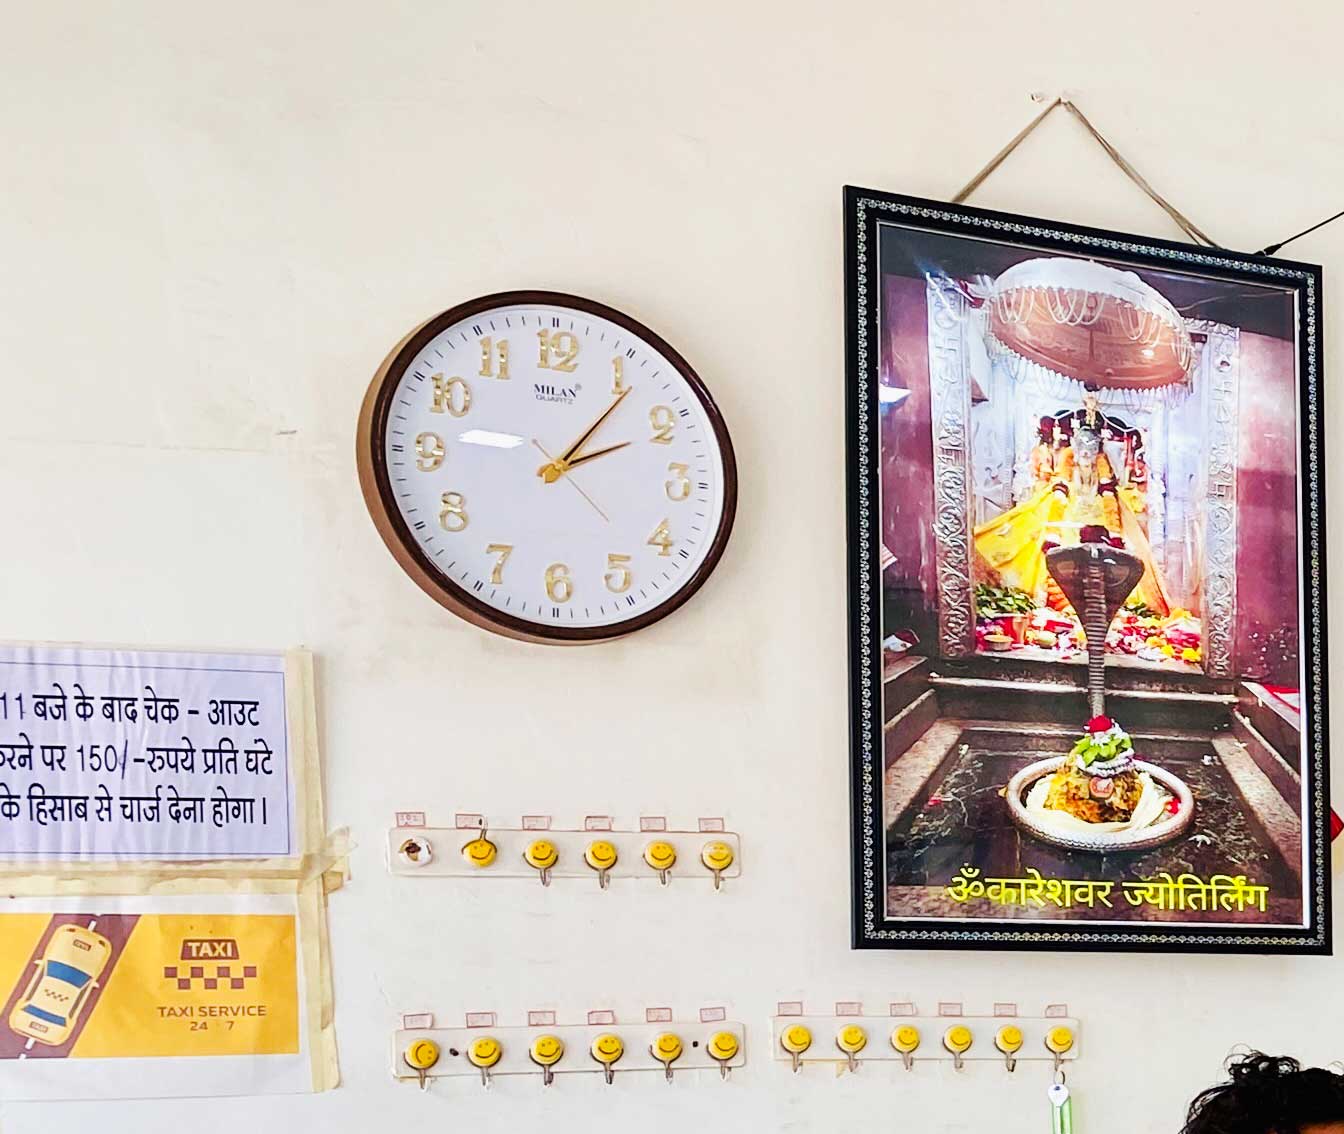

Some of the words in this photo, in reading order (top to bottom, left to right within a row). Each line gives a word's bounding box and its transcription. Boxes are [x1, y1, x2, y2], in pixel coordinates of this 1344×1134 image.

[478, 337, 511, 380] 11
[536, 329, 579, 373] 12
[429, 372, 471, 417] 10
[533, 383, 576, 398] MILAN
[611, 356, 626, 395] 1
[649, 404, 677, 445] 2
[415, 431, 446, 472] 9
[664, 462, 691, 501] 3
[438, 491, 469, 532] 8
[648, 518, 673, 557] 4
[486, 544, 513, 585] 7
[544, 563, 574, 603] 6
[604, 553, 632, 593] 5
[32, 683, 67, 721] बजे
[73, 683, 95, 722] के
[100, 696, 138, 723] बाद
[143, 685, 180, 724] चेक
[208, 699, 260, 726] आउट
[40, 745, 67, 771] पर
[202, 737, 239, 775] प्रति
[0, 782, 21, 821] के
[27, 782, 90, 826] हिसाब
[94, 784, 113, 822] से
[119, 785, 162, 822] चार्ज
[167, 785, 206, 823] देना
[211, 786, 256, 828] होगा
[1122, 872, 1269, 911] ज्योतिर्लिंग
[187, 942, 233, 958] TAXI
[157, 1005, 194, 1018] TAXI
[199, 1005, 267, 1017] SERVICE
[190, 1021, 208, 1031] 24
[226, 1021, 235, 1031] 7
